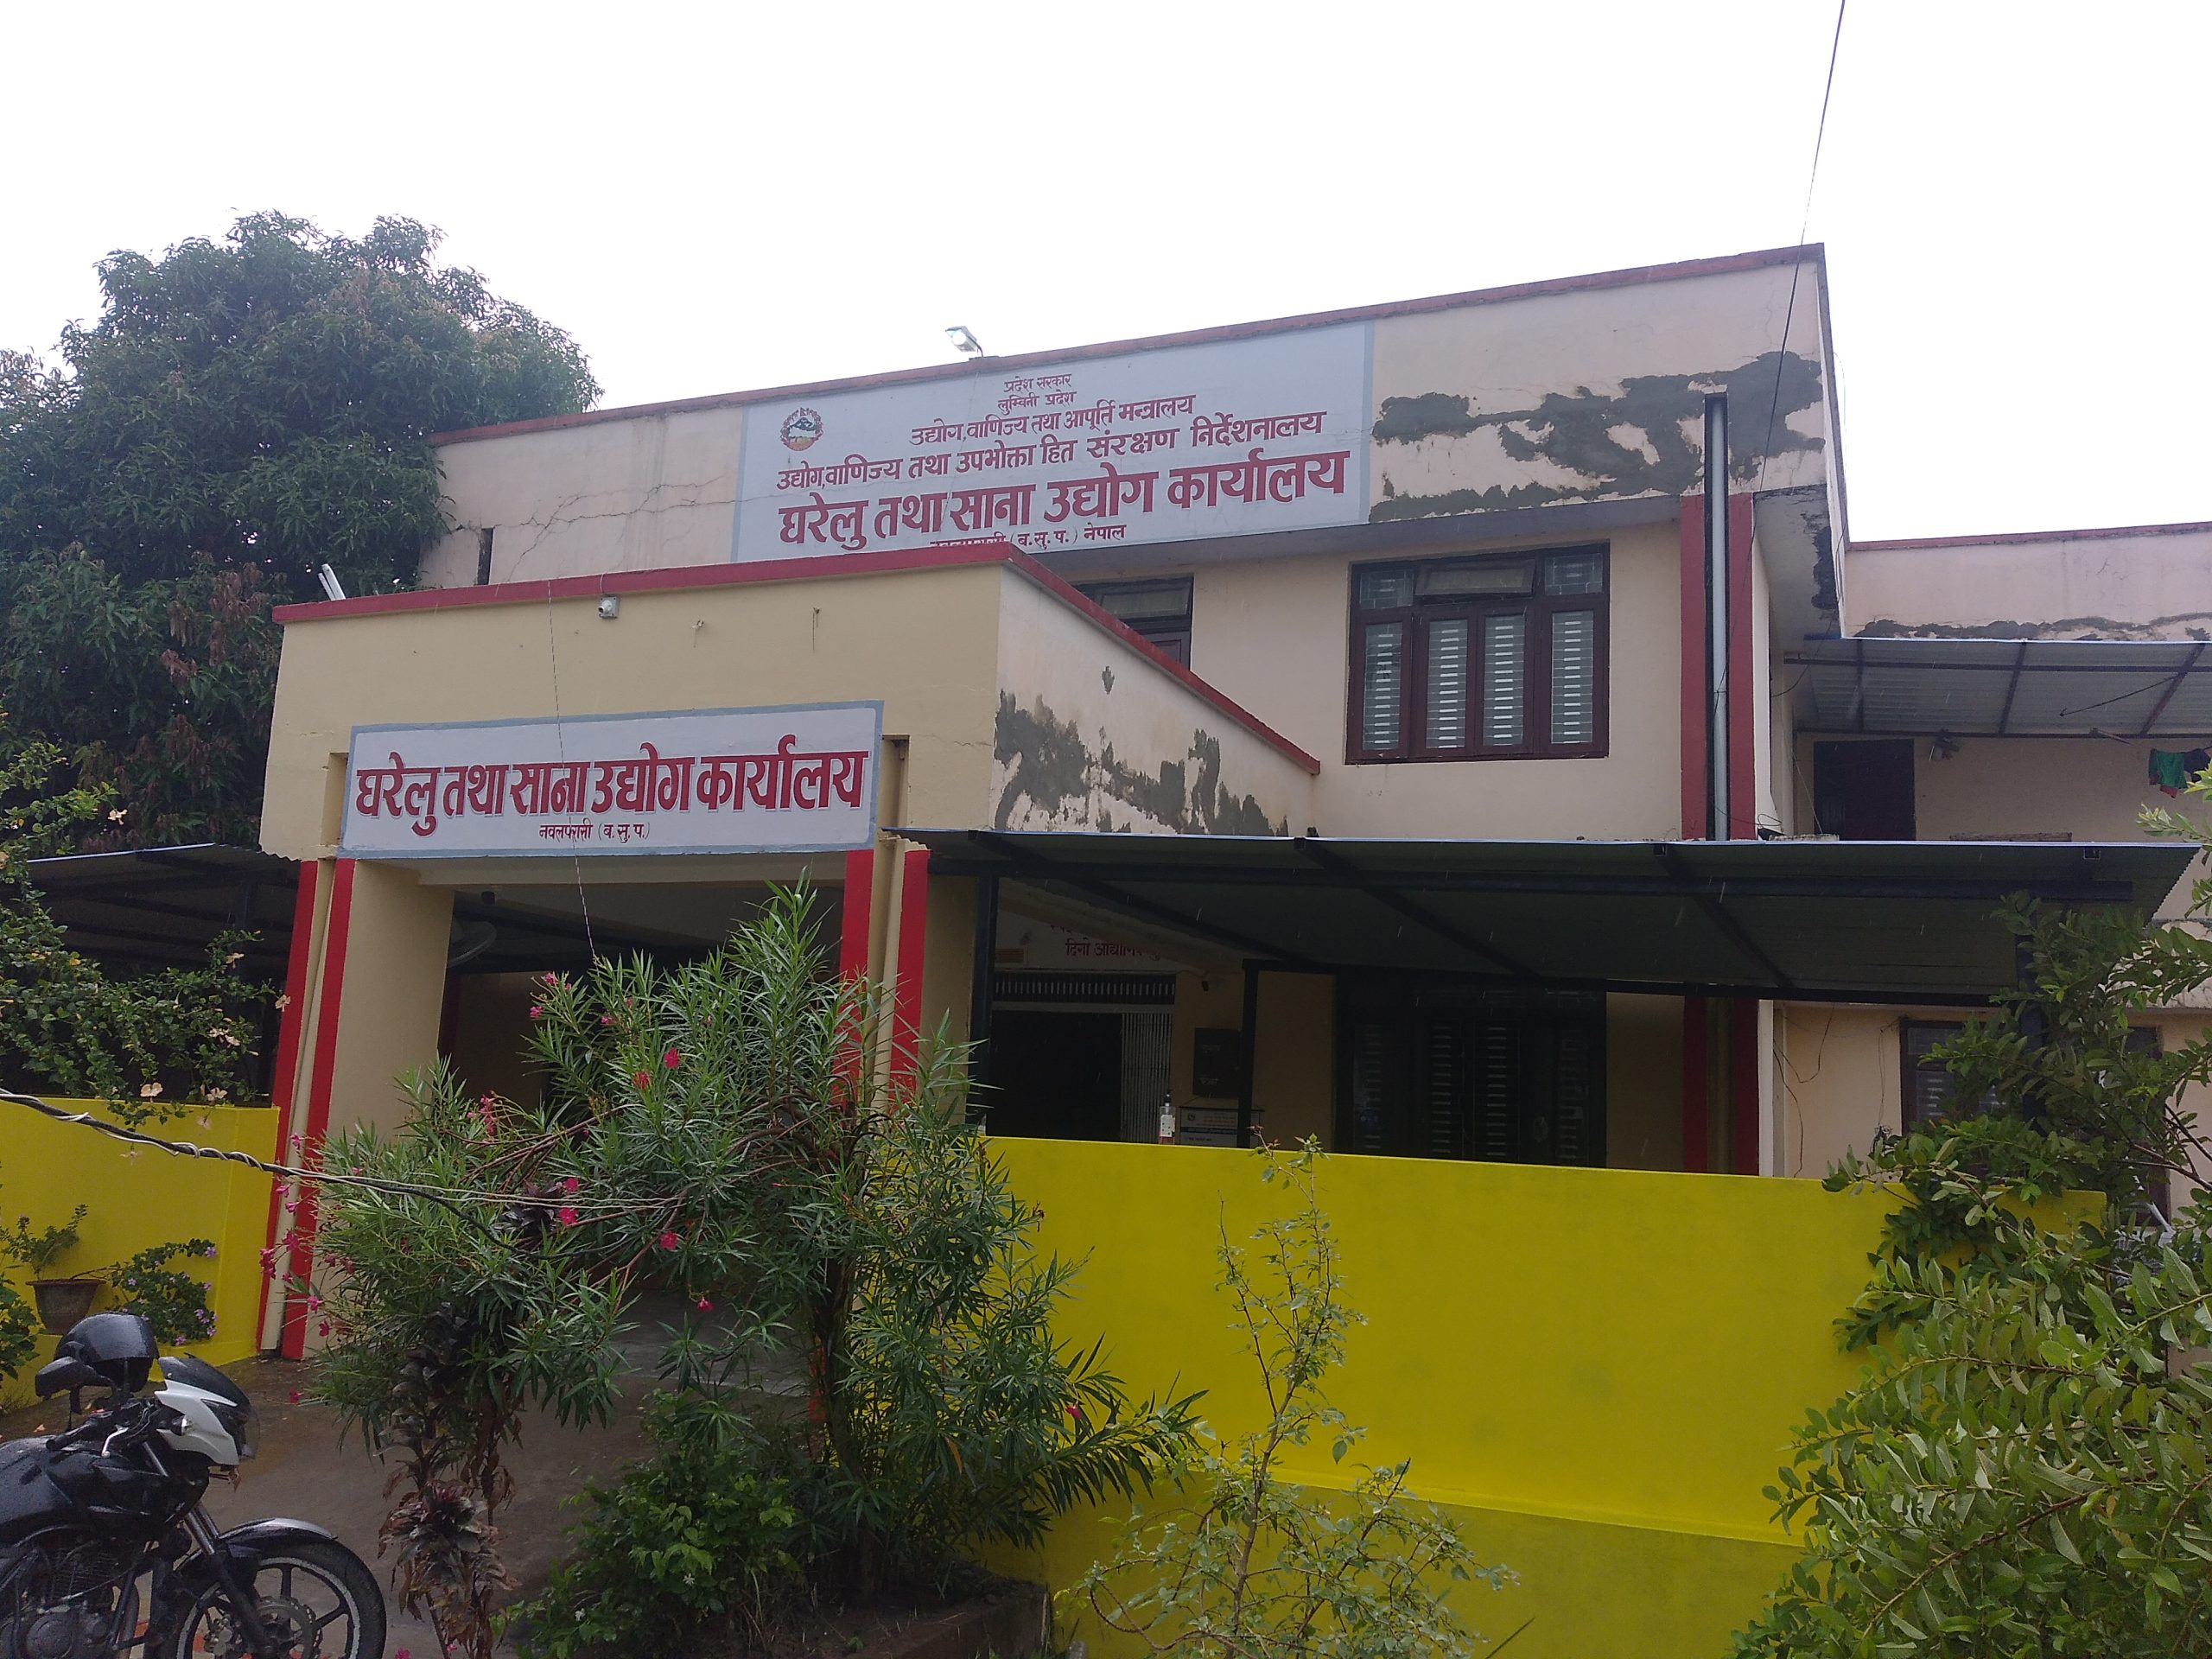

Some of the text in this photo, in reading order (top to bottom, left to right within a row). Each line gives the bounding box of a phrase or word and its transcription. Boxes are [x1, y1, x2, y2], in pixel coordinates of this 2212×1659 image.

[1003, 373, 1072, 394] प्रदेश सरकार
[1045, 389, 1077, 407] प्रदेश
[1031, 412, 1061, 435] तथा
[1064, 399, 1116, 431] आपूर्ति
[1118, 394, 1197, 423] मन्त्रालय
[908, 453, 951, 479] तथा
[956, 439, 1037, 474] उपभोक्ता
[1039, 433, 1078, 465] हित
[1086, 429, 1181, 459] संरक्षण
[1190, 411, 1328, 448] निर्देशनालय
[778, 447, 1351, 550] घरेलु तथा साना उद्योग कार्यालय
[1084, 522, 1128, 541] नेपाल
[356, 734, 869, 836] घरेलु तथा साना उद्योग कार्यालय
[538, 817, 594, 843] नवलपरासी
